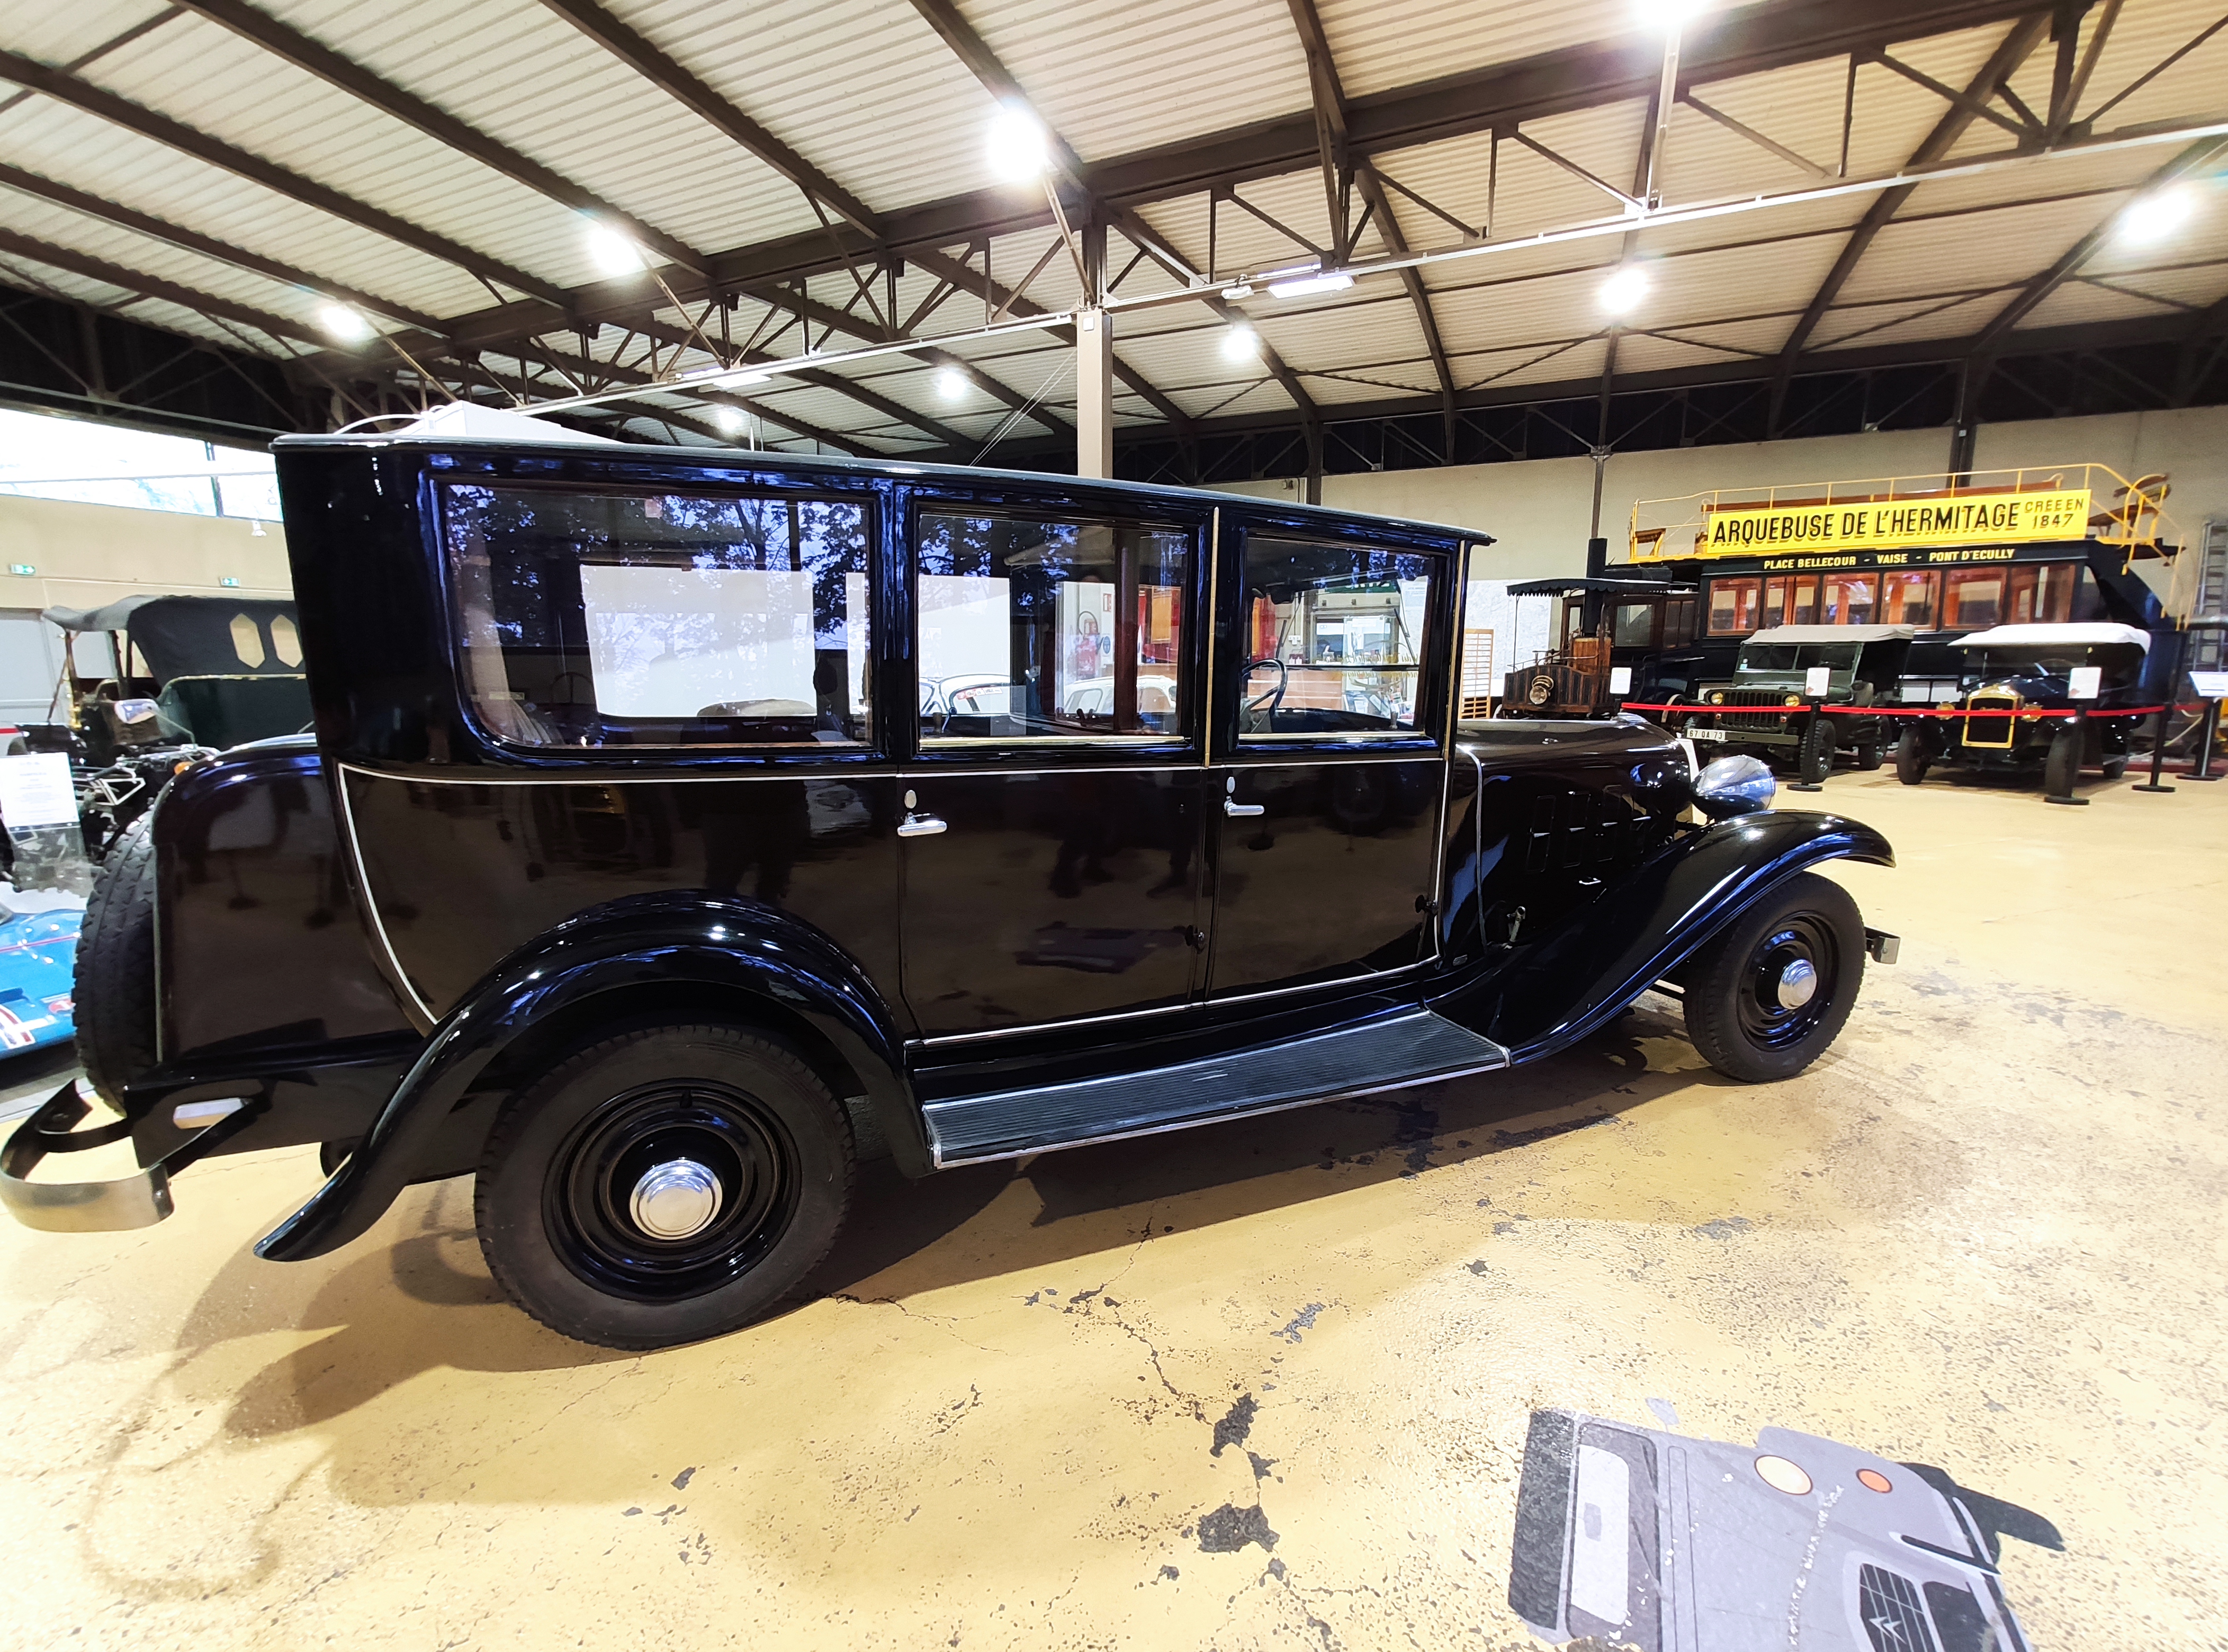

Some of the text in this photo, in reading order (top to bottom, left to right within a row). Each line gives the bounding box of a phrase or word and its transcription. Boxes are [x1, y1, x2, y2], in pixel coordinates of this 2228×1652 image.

[2065, 498, 2084, 510] EN
[1713, 502, 2022, 545] ARQUEBUSE DE L'HERMITAGE
[2033, 513, 2074, 529] 1847
[1764, 559, 1794, 570] PLACE
[1797, 555, 1856, 568] BELLECOUR
[1876, 553, 1908, 564] VAISE
[1928, 550, 1960, 562] PONT
[1961, 549, 2016, 561] D'ECULLY
